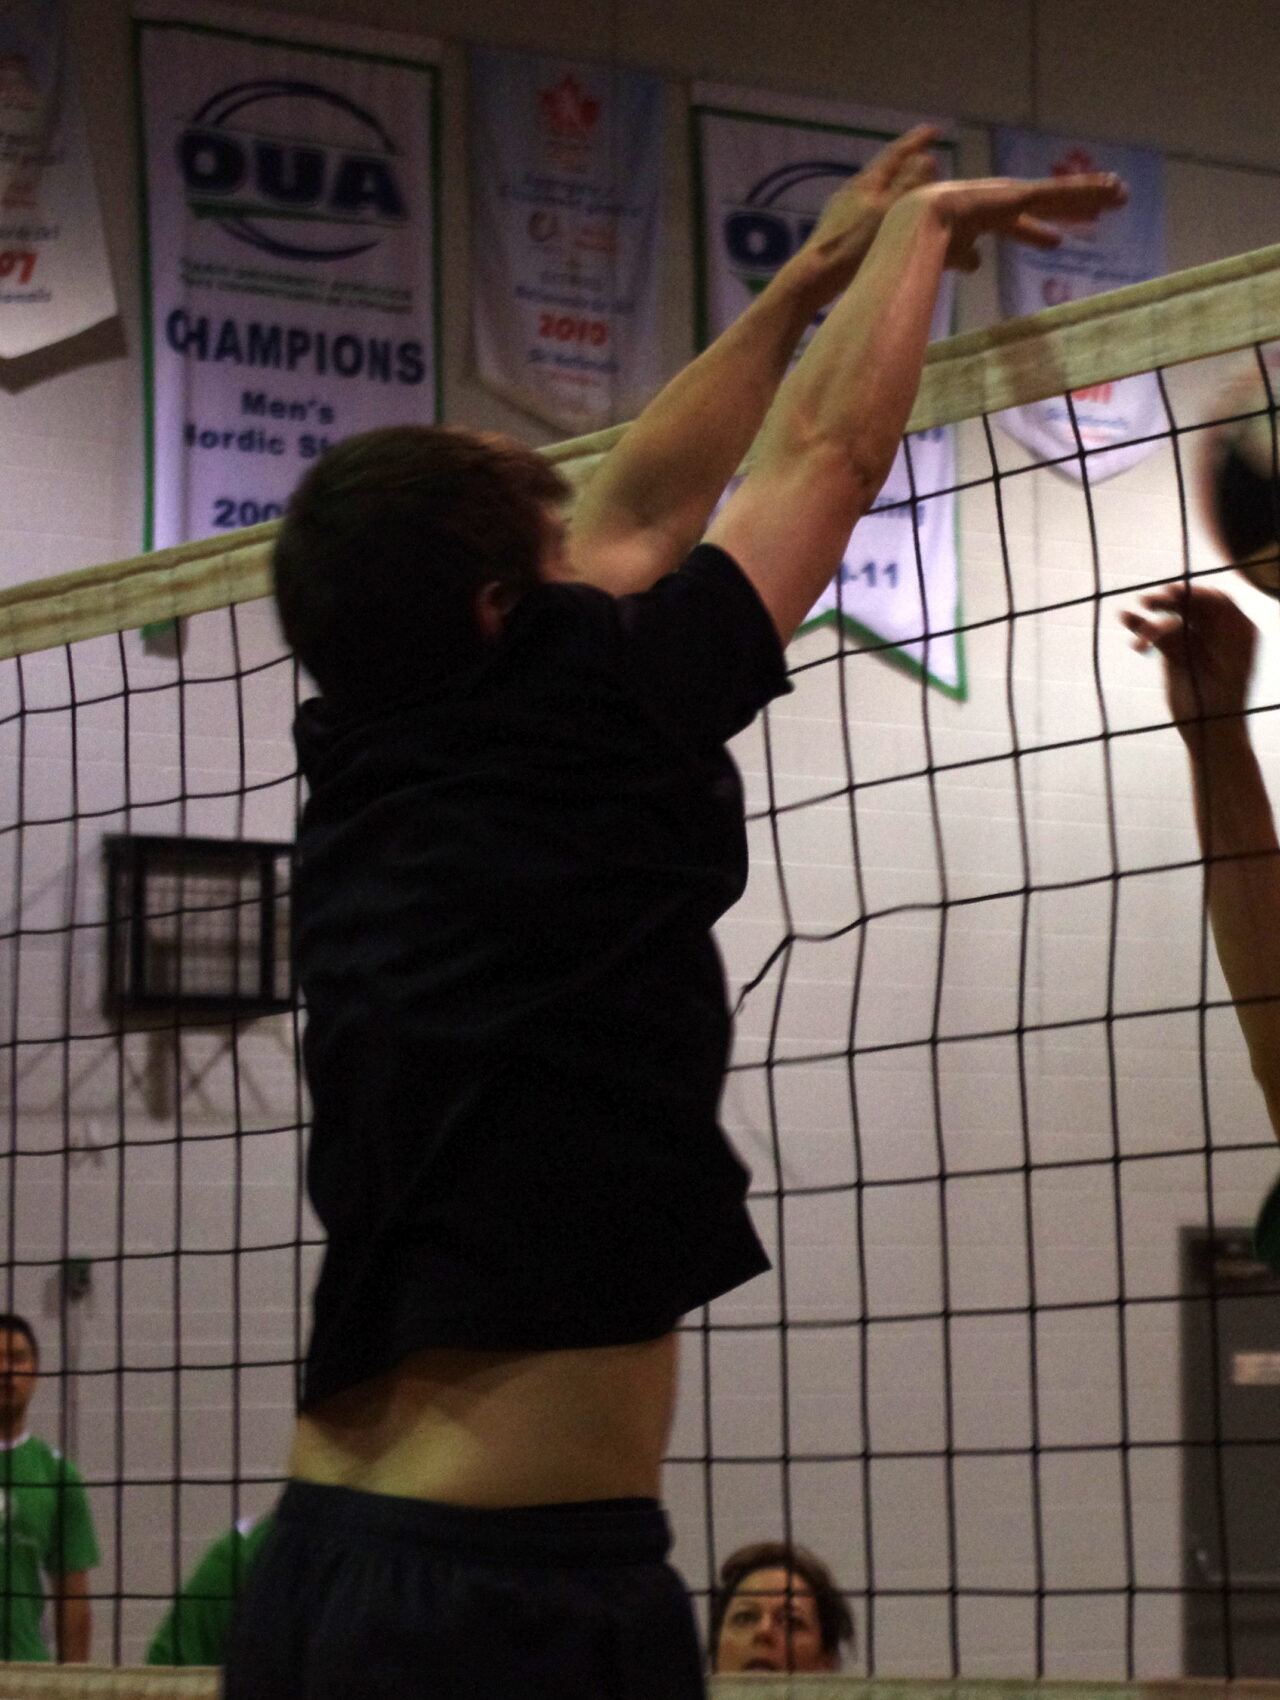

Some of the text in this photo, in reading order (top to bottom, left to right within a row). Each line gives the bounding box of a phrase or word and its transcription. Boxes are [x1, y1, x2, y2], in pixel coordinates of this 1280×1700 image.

[174, 126, 411, 222] OUA
[165, 309, 427, 386] CHAMPIONS
[240, 391, 337, 426] Men's
